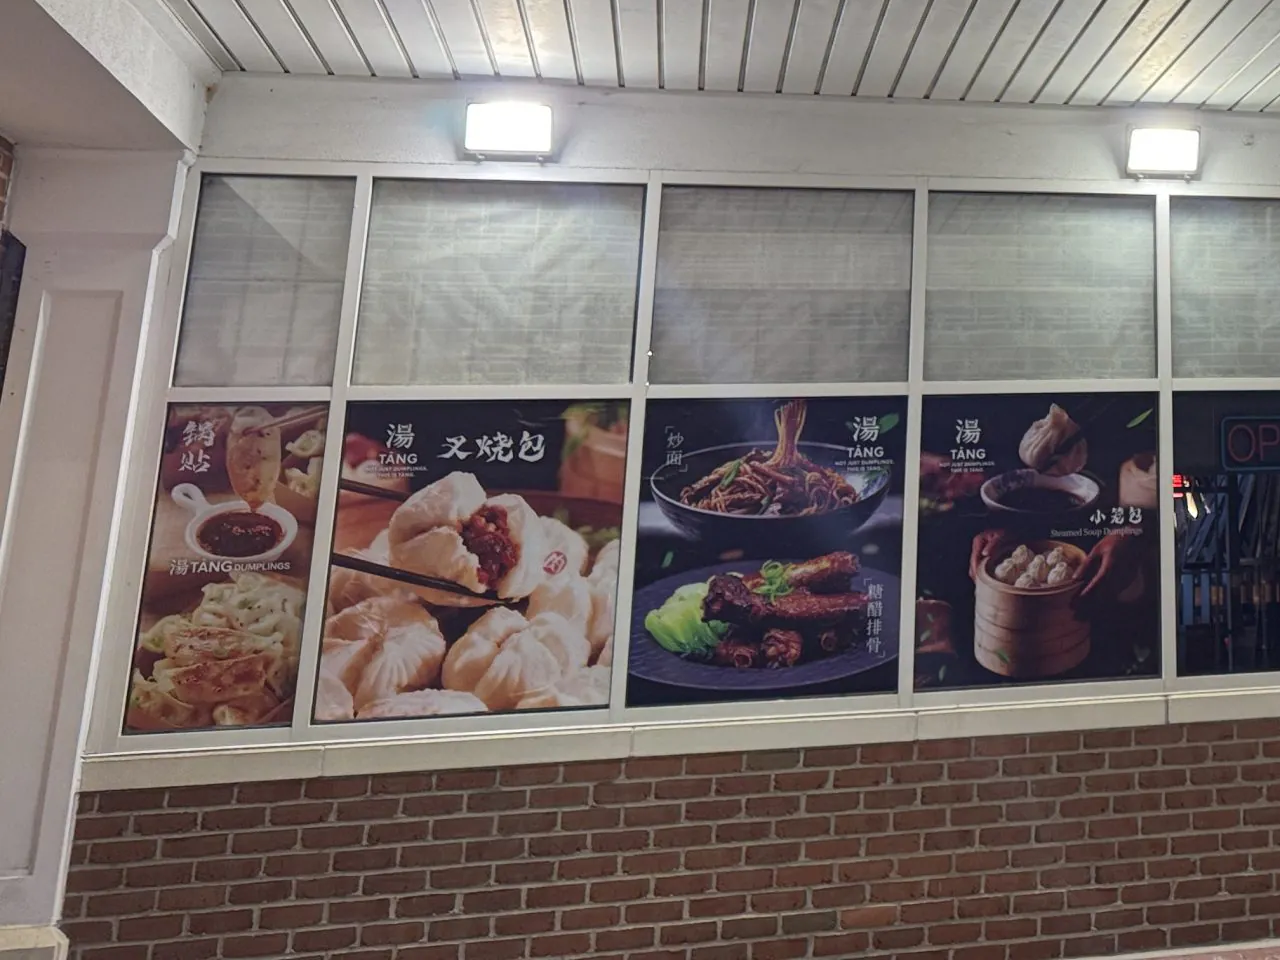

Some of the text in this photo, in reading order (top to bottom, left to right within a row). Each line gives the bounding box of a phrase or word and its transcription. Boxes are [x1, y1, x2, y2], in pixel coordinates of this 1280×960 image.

[386, 424, 415, 449] 湯
[853, 416, 880, 442] 湯
[955, 419, 982, 444] 湯
[437, 431, 547, 463] 叉烧包
[1083, 527, 1102, 538] Soup
[1103, 525, 1143, 537] Dumplings
[169, 559, 189, 576] 湯
[234, 561, 290, 572] DUMPLINGS
